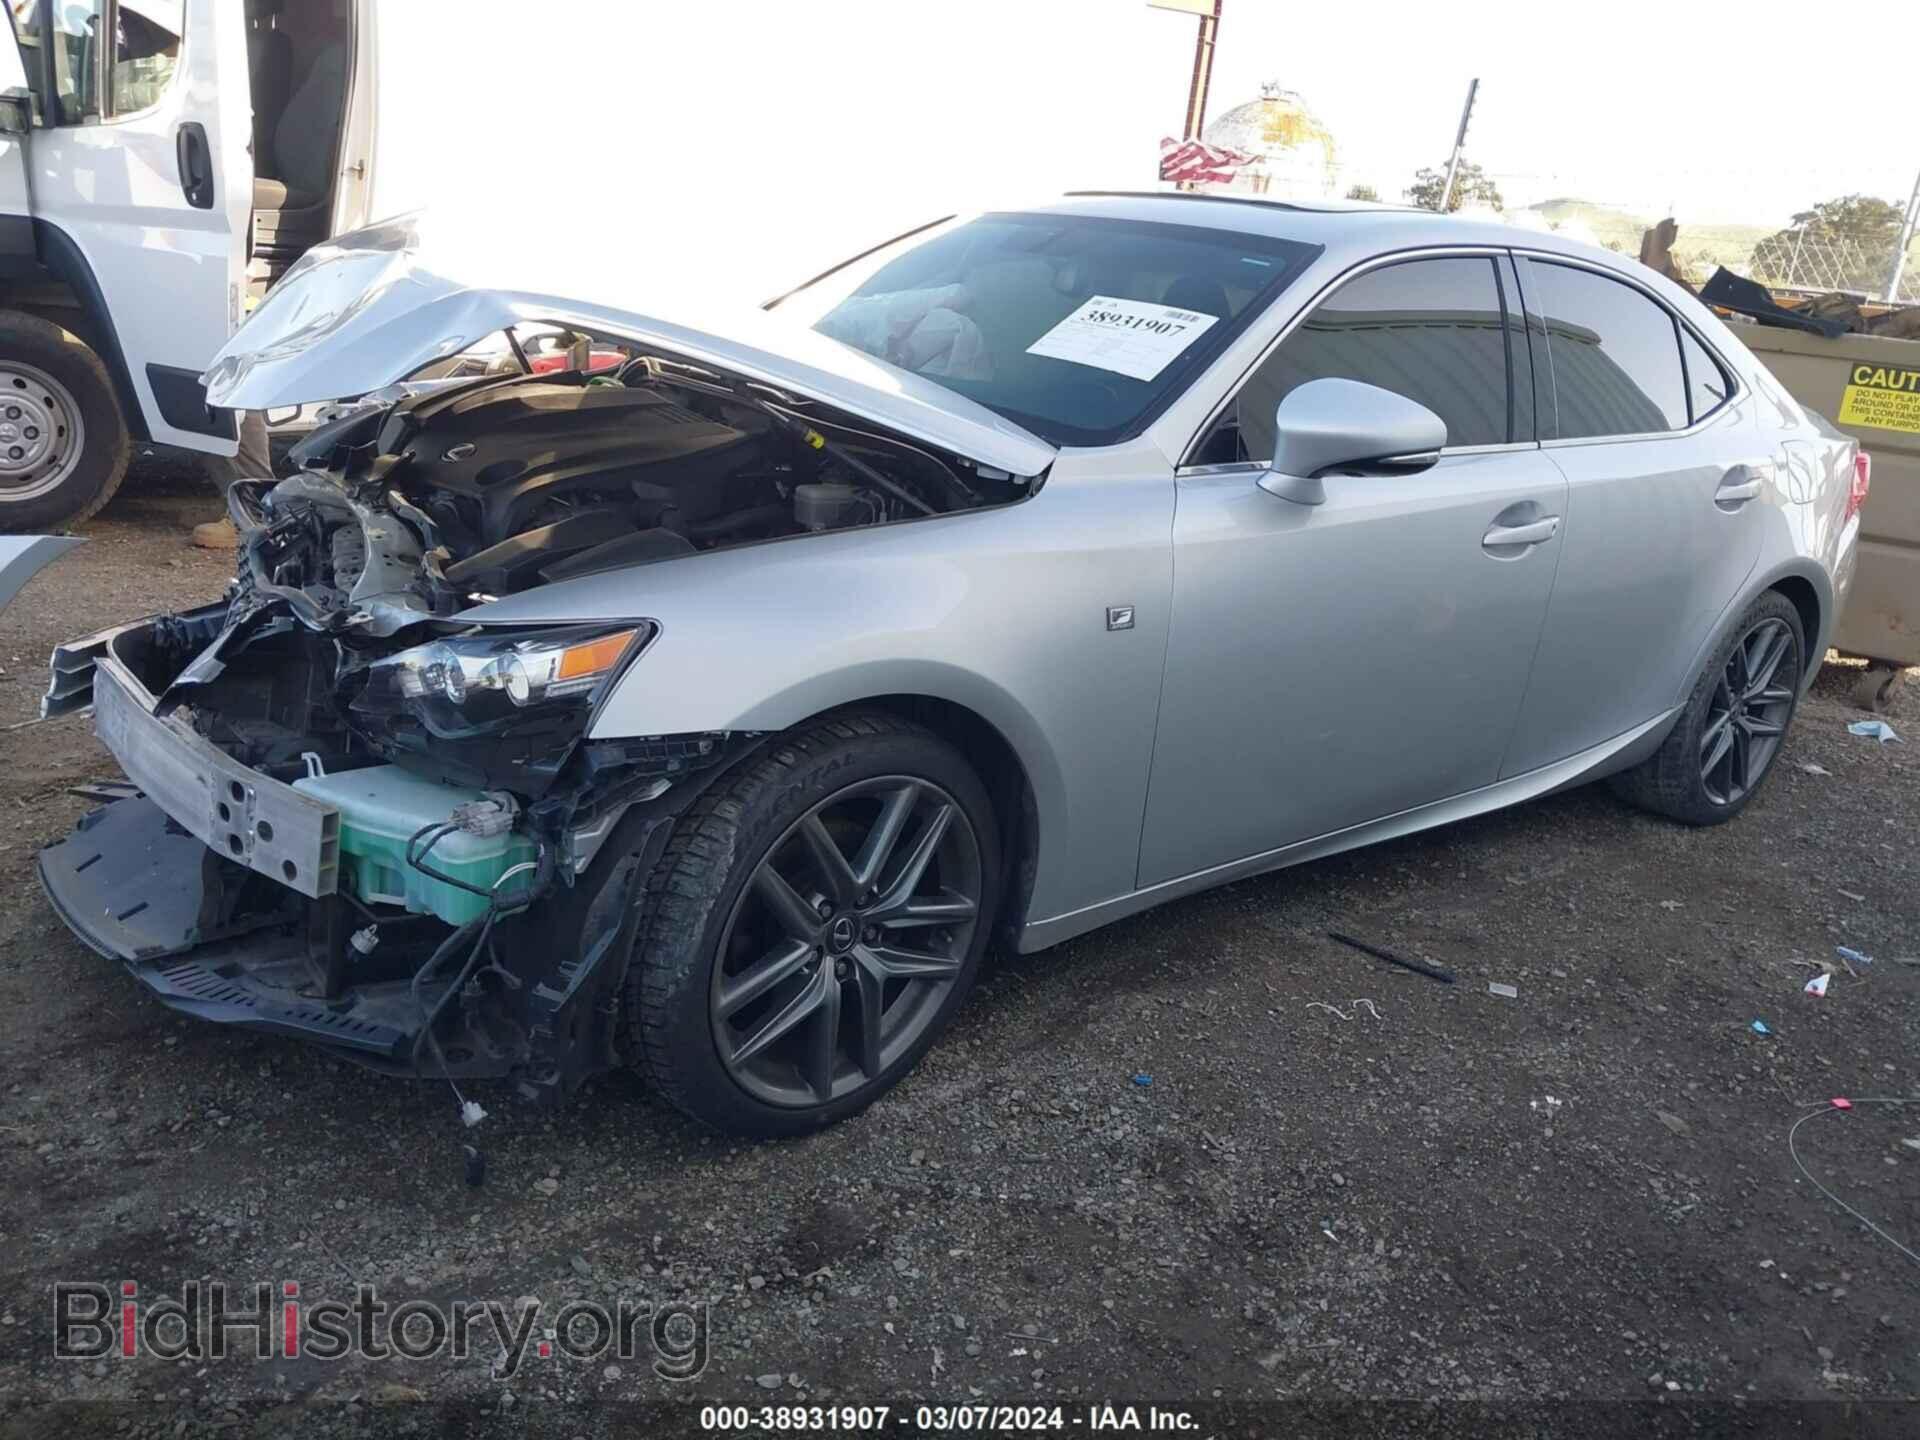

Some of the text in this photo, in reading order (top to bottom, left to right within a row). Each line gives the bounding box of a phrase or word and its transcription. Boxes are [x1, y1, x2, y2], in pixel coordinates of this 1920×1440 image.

[1081, 309, 1188, 337] 38931907
[1856, 389, 1870, 398] DO
[1872, 391, 1894, 400] NOT
[1851, 398, 1894, 409] AROUND
[1864, 416, 1882, 425] ANY
